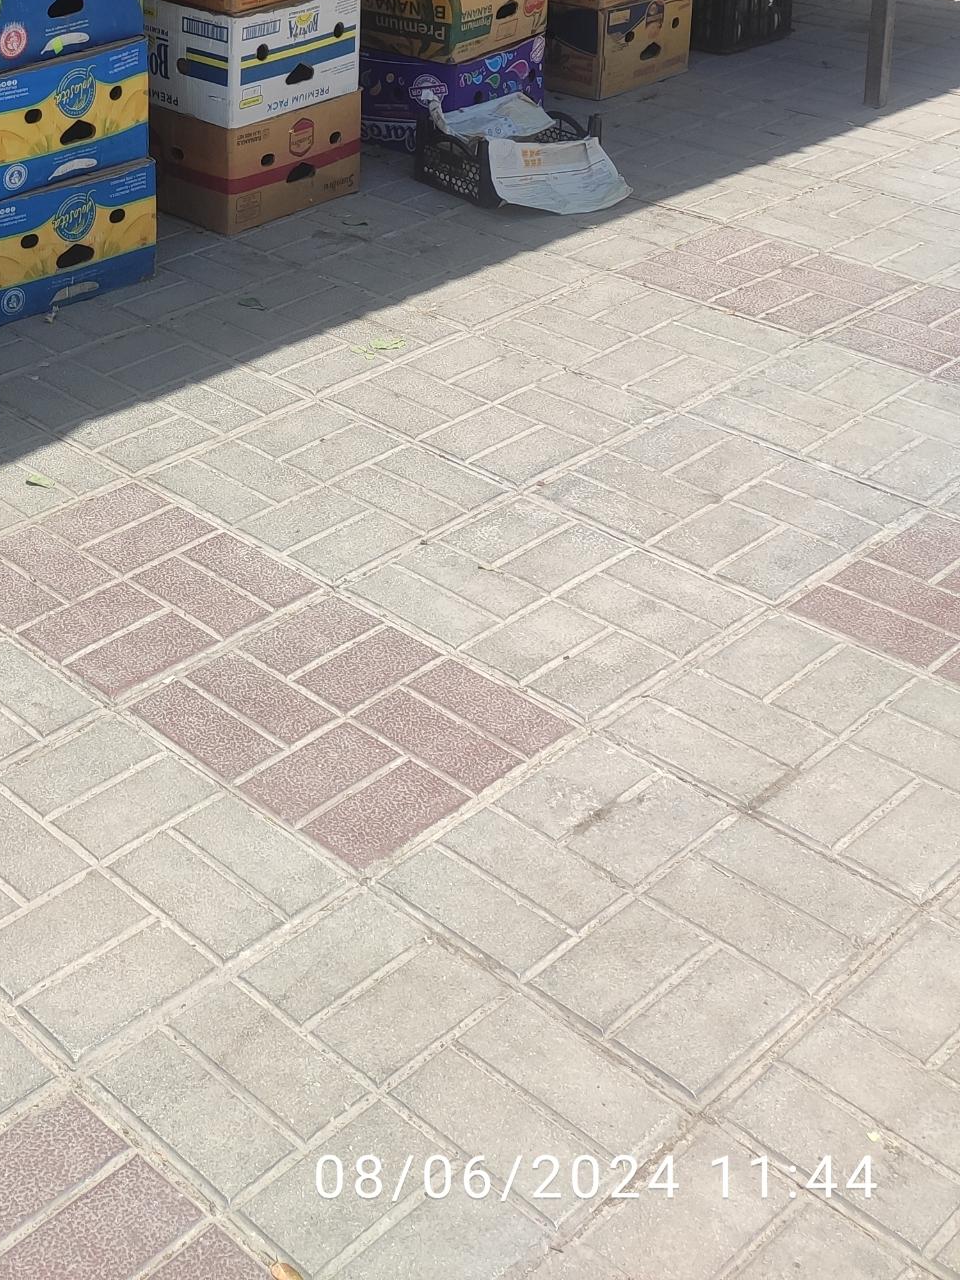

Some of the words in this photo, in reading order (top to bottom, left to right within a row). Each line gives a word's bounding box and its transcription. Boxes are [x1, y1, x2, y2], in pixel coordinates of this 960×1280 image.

[375, 16, 445, 39] Premium
[461, 18, 491, 32] Premium
[292, 86, 329, 103] PREMIUM
[267, 98, 288, 112] PACK
